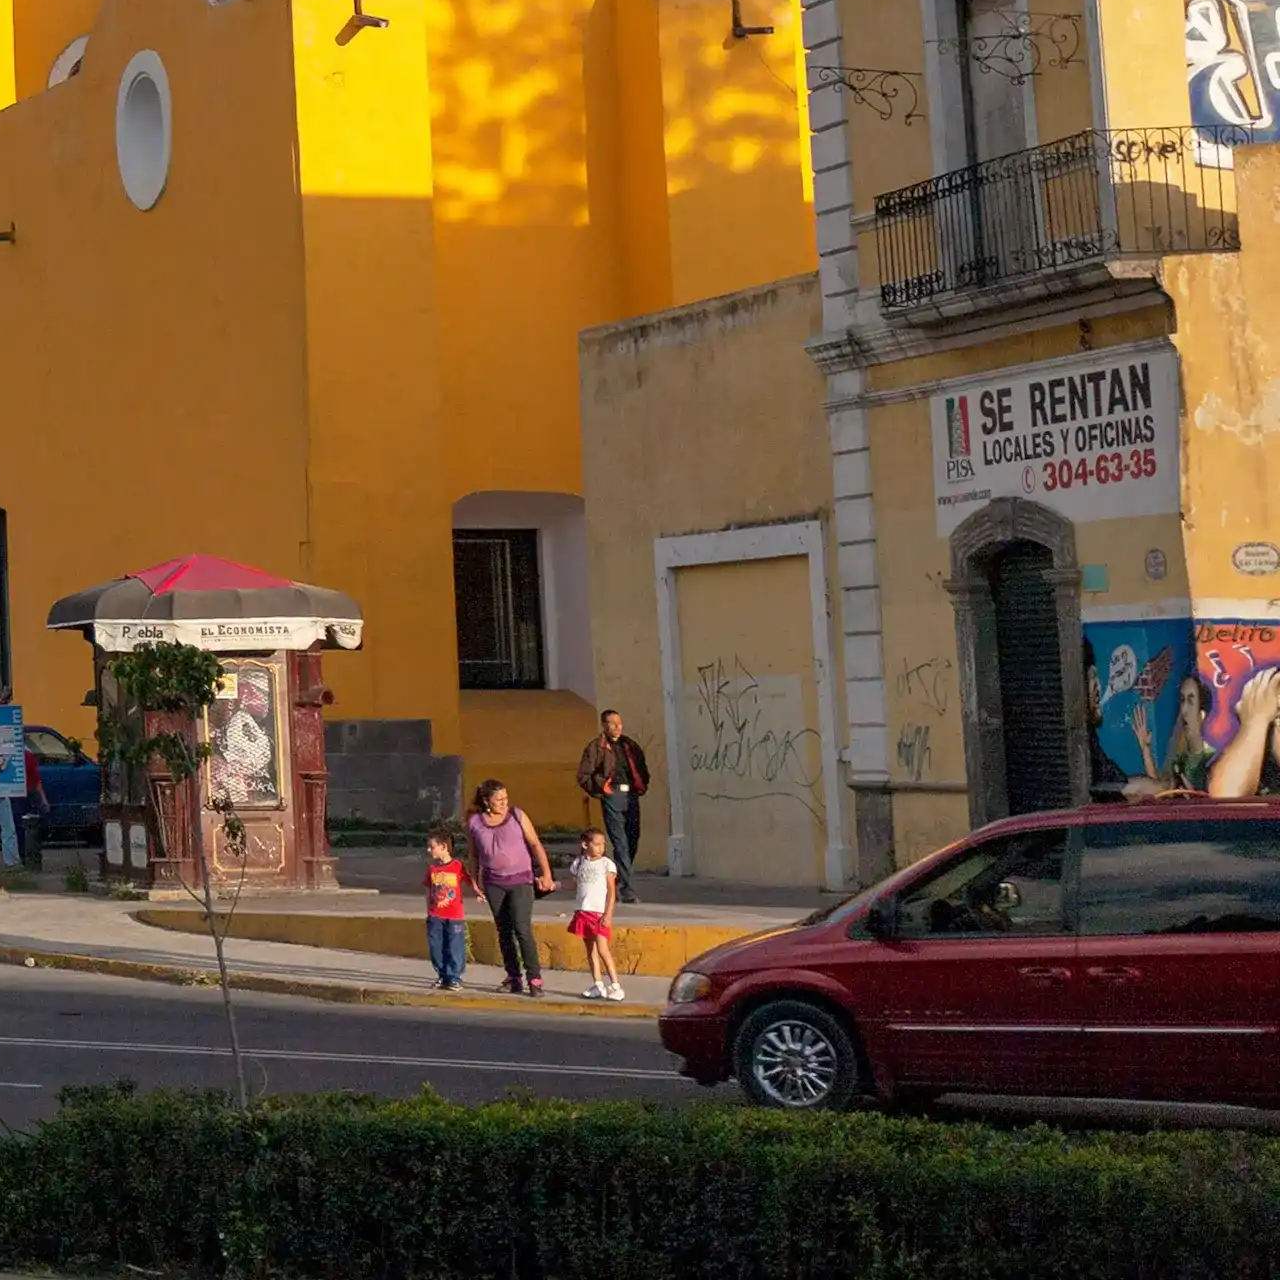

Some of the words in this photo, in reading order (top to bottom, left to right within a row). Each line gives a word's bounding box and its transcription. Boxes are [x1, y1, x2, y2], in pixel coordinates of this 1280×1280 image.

[979, 387, 1014, 435] SE
[1029, 362, 1152, 427] RENTAN
[982, 431, 1055, 466] LOCALES
[1060, 428, 1071, 454] Y
[1074, 415, 1155, 453] OFICINAS
[946, 458, 976, 480] PISA
[1042, 448, 1157, 492] 304-63-35
[122, 624, 163, 639] Pebla
[201, 627, 214, 636] EL
[217, 624, 290, 635] ECONOMISTA
